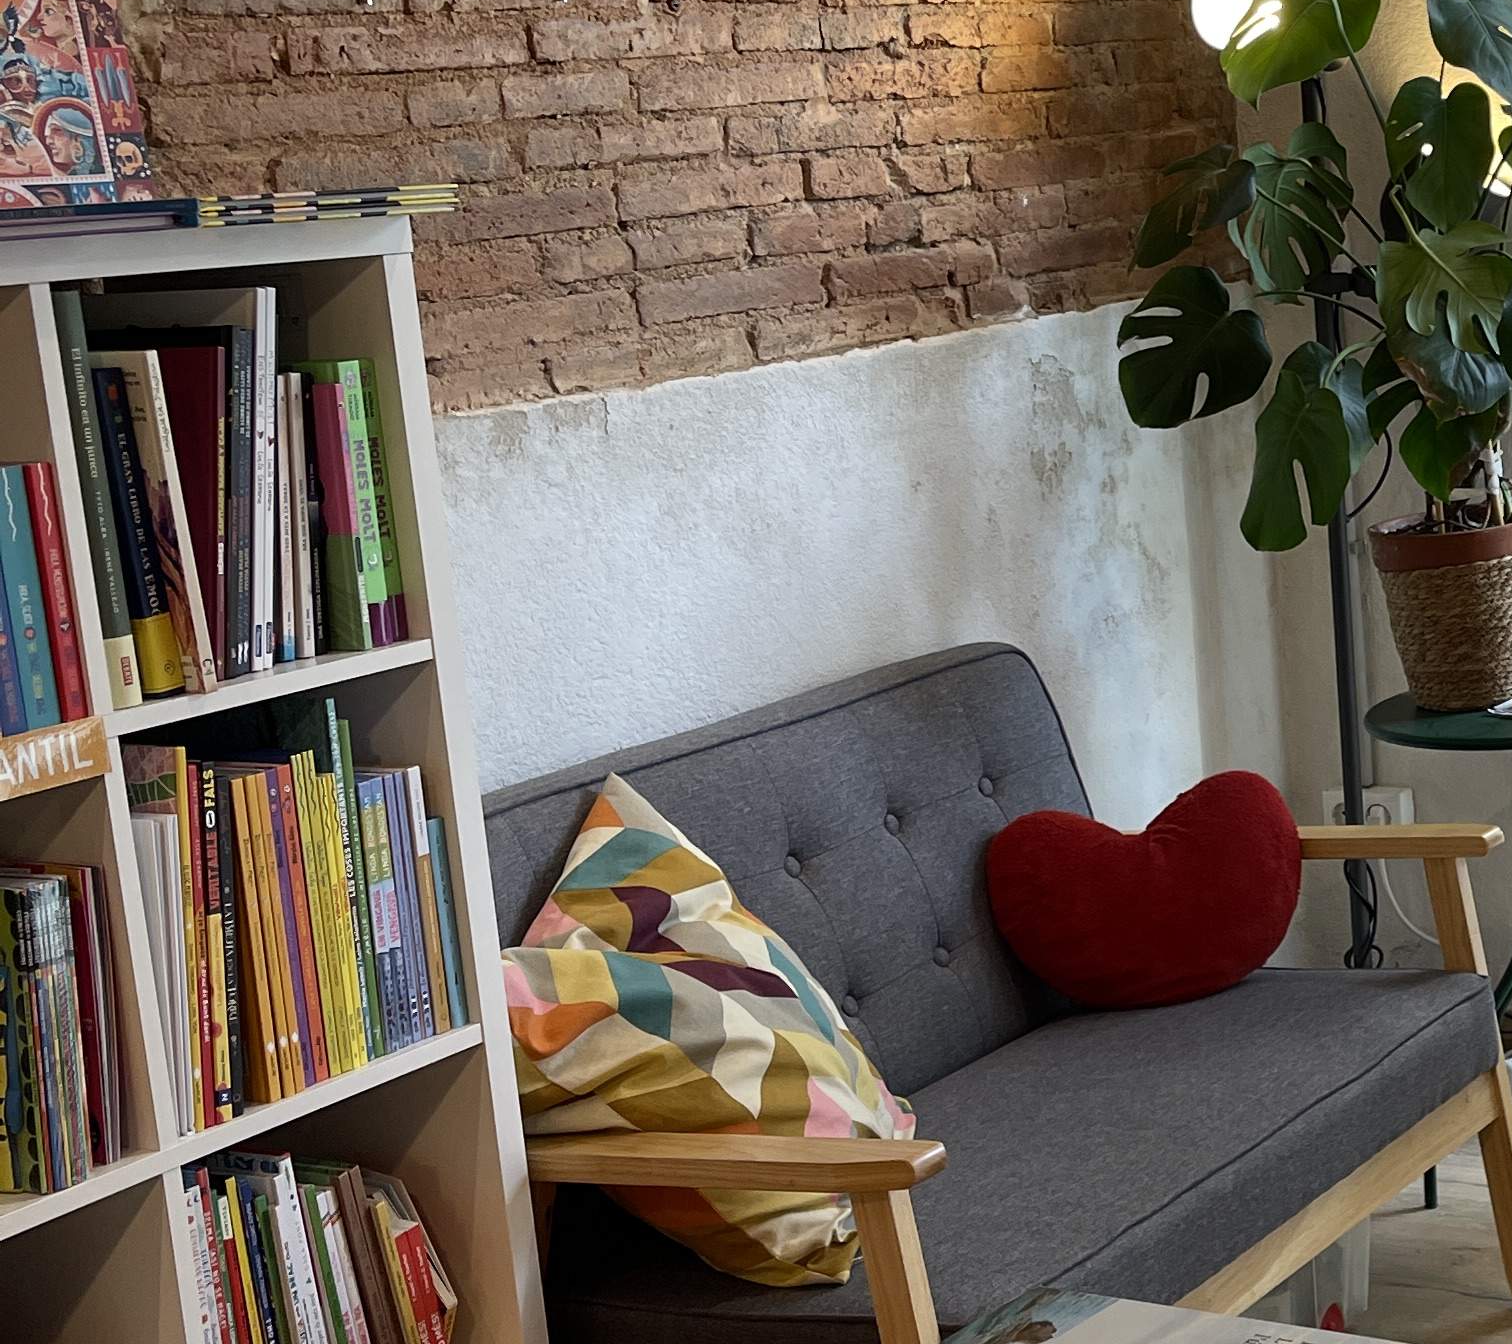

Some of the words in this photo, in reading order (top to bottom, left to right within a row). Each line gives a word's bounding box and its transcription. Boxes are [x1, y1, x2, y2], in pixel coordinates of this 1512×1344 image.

[72, 362, 91, 408] infinito
[80, 408, 92, 425] en
[83, 426, 95, 443] un
[84, 443, 103, 479] junco
[351, 438, 371, 490] MOLES
[359, 497, 377, 544] MOLT
[373, 494, 391, 540] MOLT
[203, 767, 215, 811] FALS
